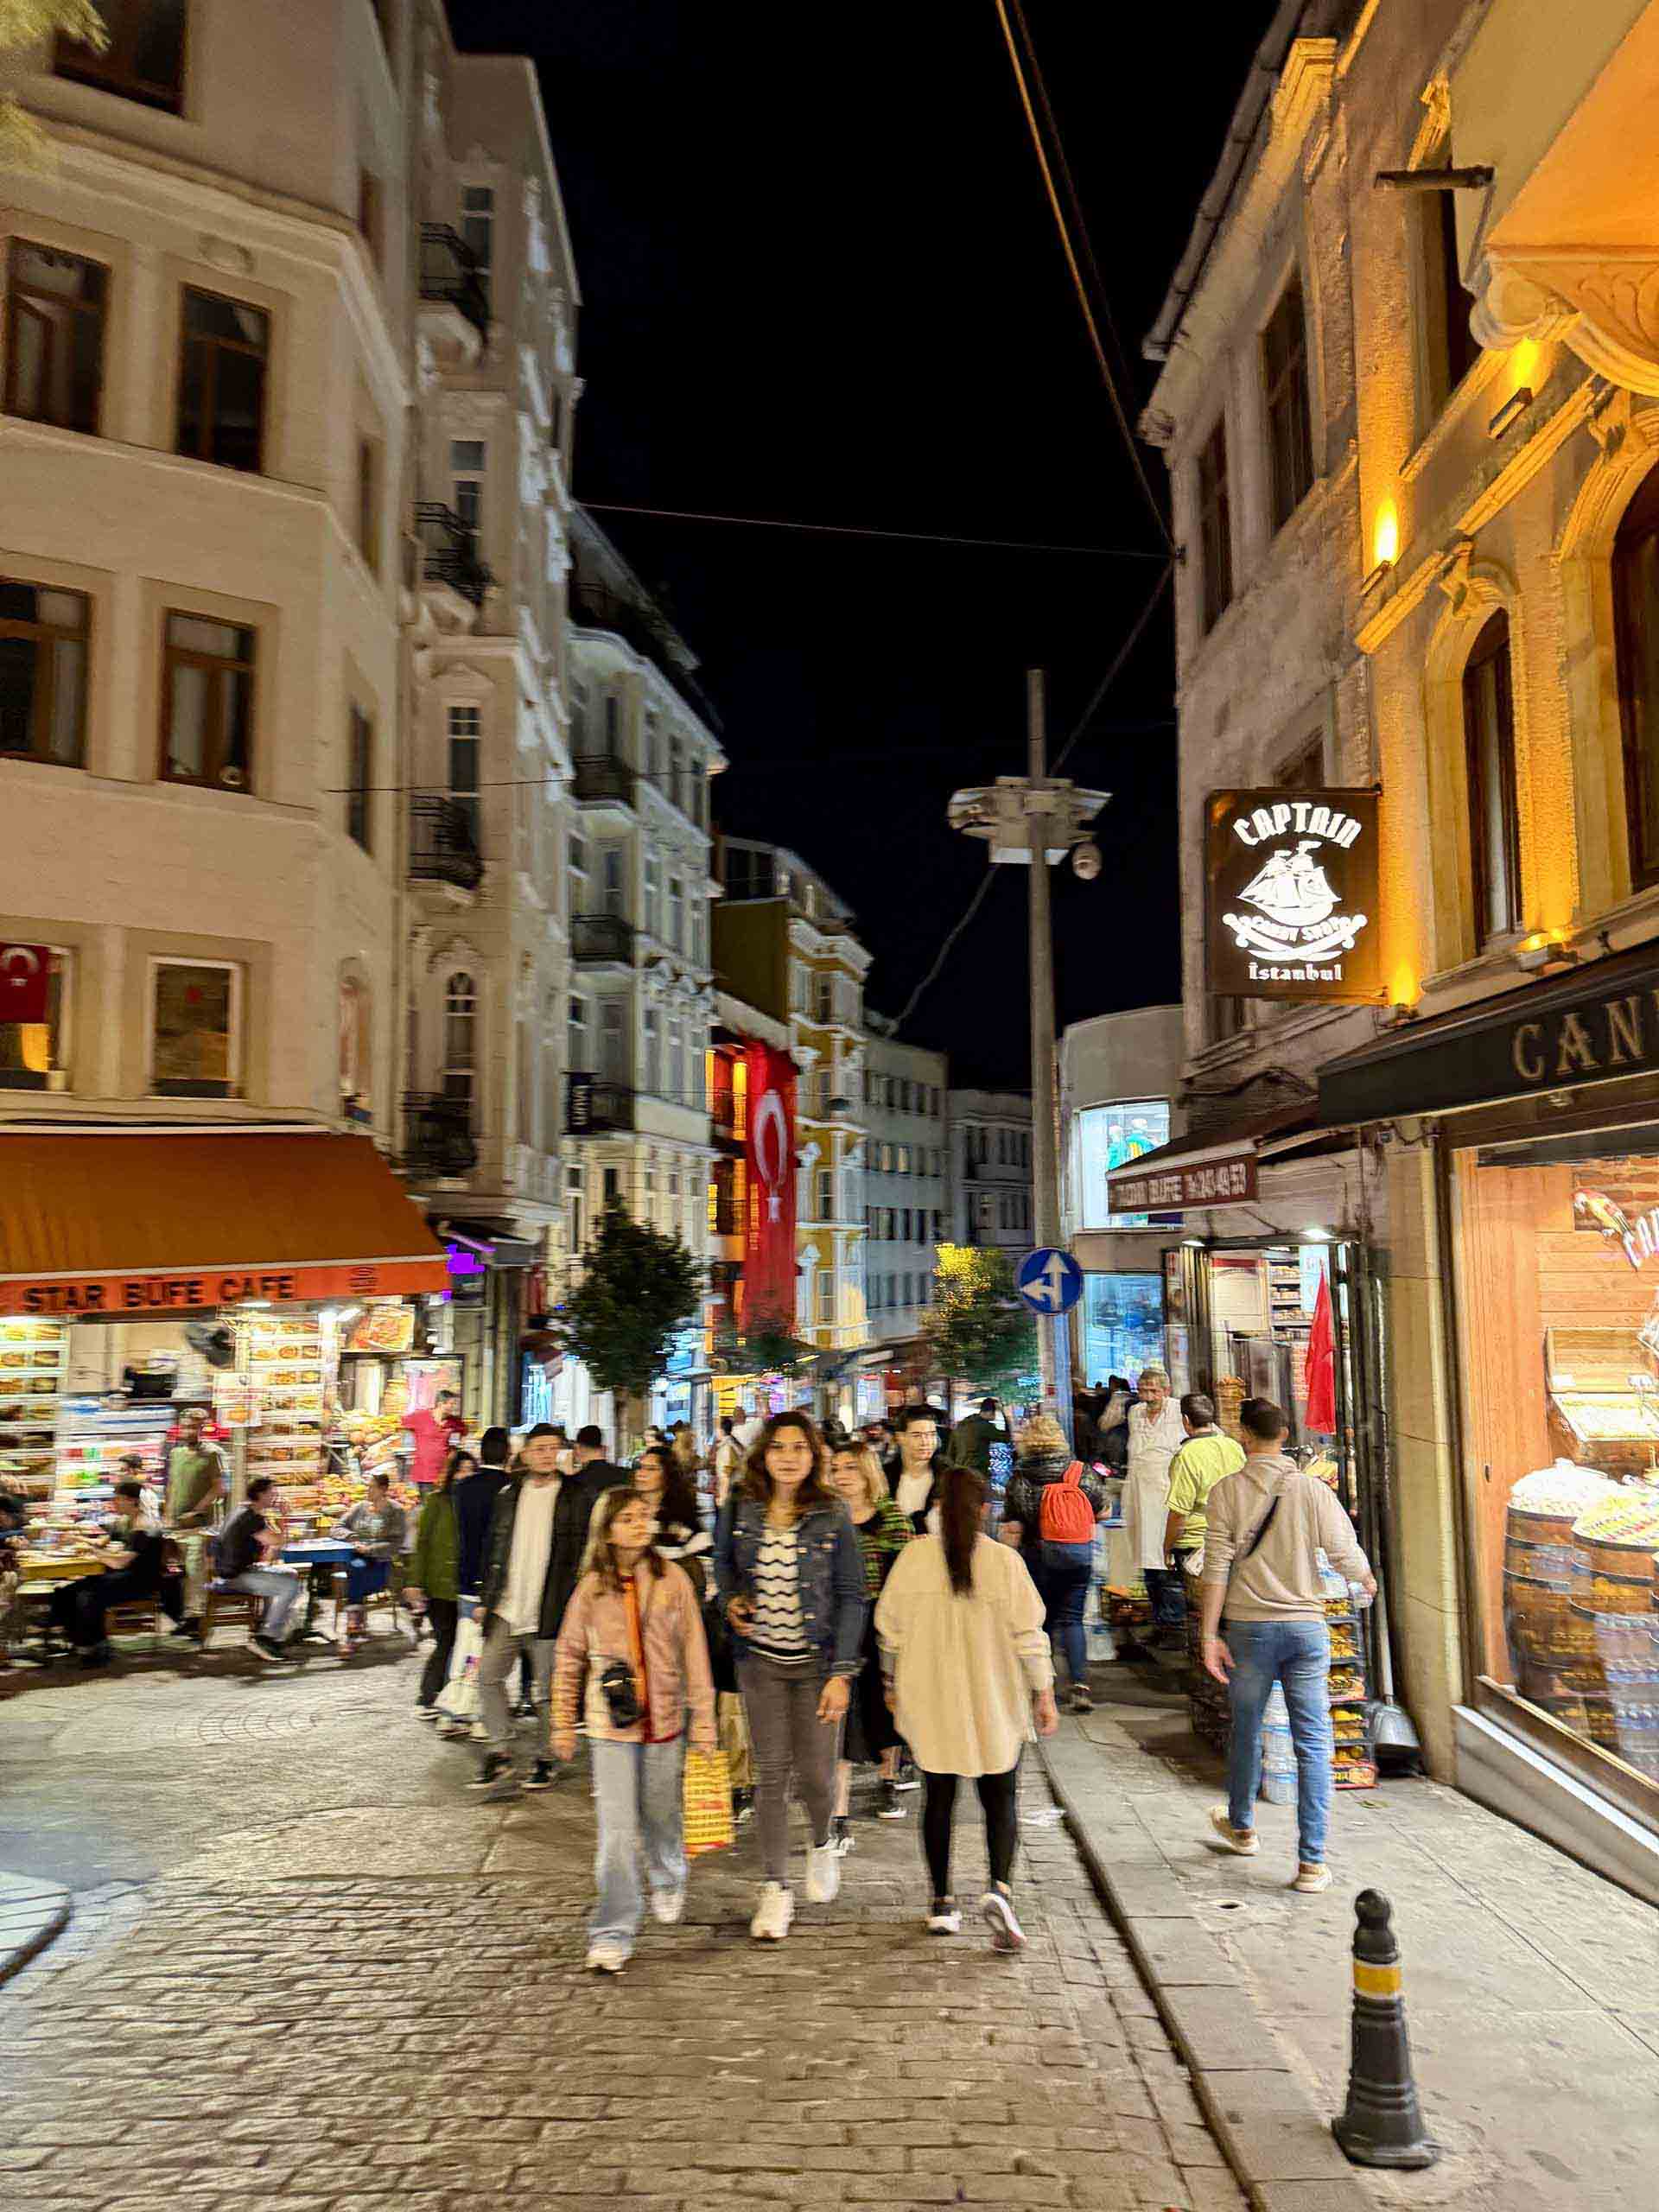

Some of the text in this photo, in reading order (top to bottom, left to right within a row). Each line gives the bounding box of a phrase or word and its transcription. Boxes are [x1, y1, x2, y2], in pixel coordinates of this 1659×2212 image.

[1233, 803, 1362, 849] CAPTAIN
[23, 1284, 105, 1313] STAR
[219, 1274, 295, 1302] CAFE
